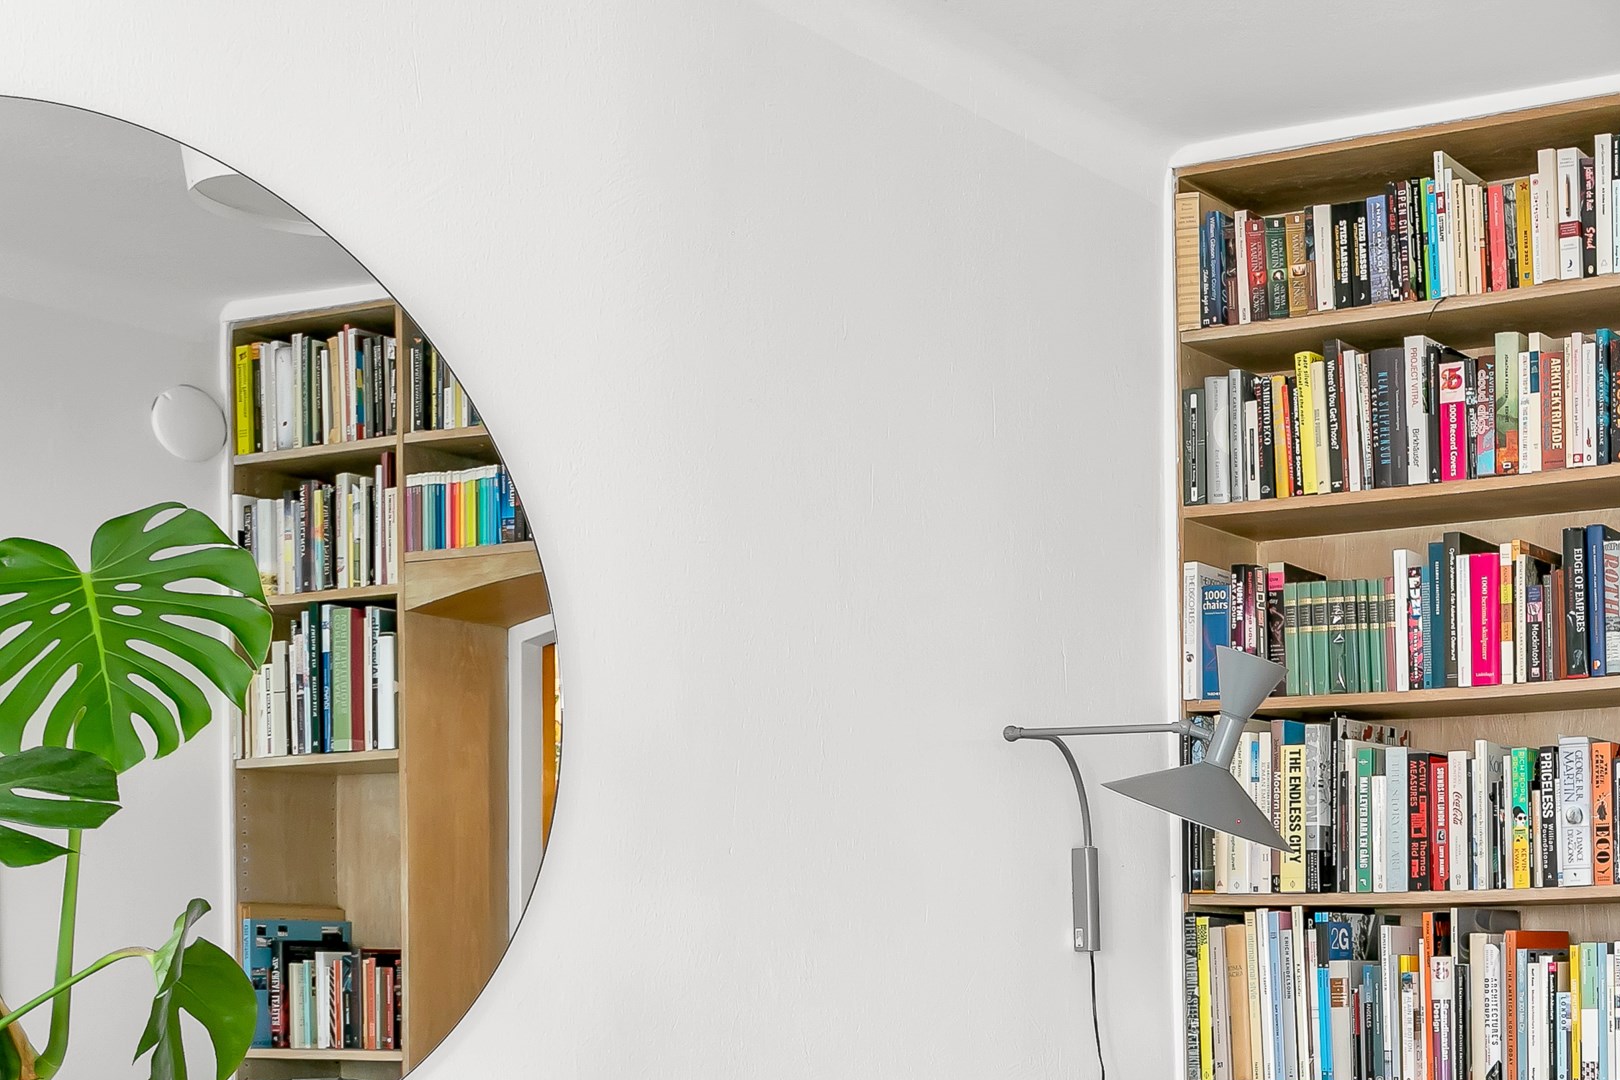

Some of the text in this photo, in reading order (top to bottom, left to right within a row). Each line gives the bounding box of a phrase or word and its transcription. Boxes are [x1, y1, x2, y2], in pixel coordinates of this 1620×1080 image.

[1398, 190, 1407, 240] OPEN CITY
[1358, 217, 1367, 281] STIEG LARSSON
[1327, 360, 1336, 392] Where'd
[1263, 380, 1271, 425] UMBERTO
[1371, 388, 1379, 448] SEVENEVES
[1378, 371, 1391, 465] NEAL STEPHENSON
[1449, 404, 1457, 423] 1000
[1551, 358, 1562, 449] ARKITEKTRITADE
[1450, 452, 1458, 476] Covers
[1203, 590, 1226, 600] 1000
[1203, 600, 1228, 610] chairs
[1574, 548, 1585, 632] EDGE OF EMPIRES
[1604, 553, 1620, 617] ROTH
[1531, 624, 1540, 666] Mackintosh
[1410, 760, 1418, 806] MEASURES
[1541, 752, 1553, 818] PRICELESS
[1563, 751, 1574, 802] MARTIN
[1289, 749, 1301, 863] THE ENDLESS CITY
[1596, 826, 1610, 863] ECO
[1331, 928, 1350, 950] 2G
[1433, 1003, 1441, 1032] Design
